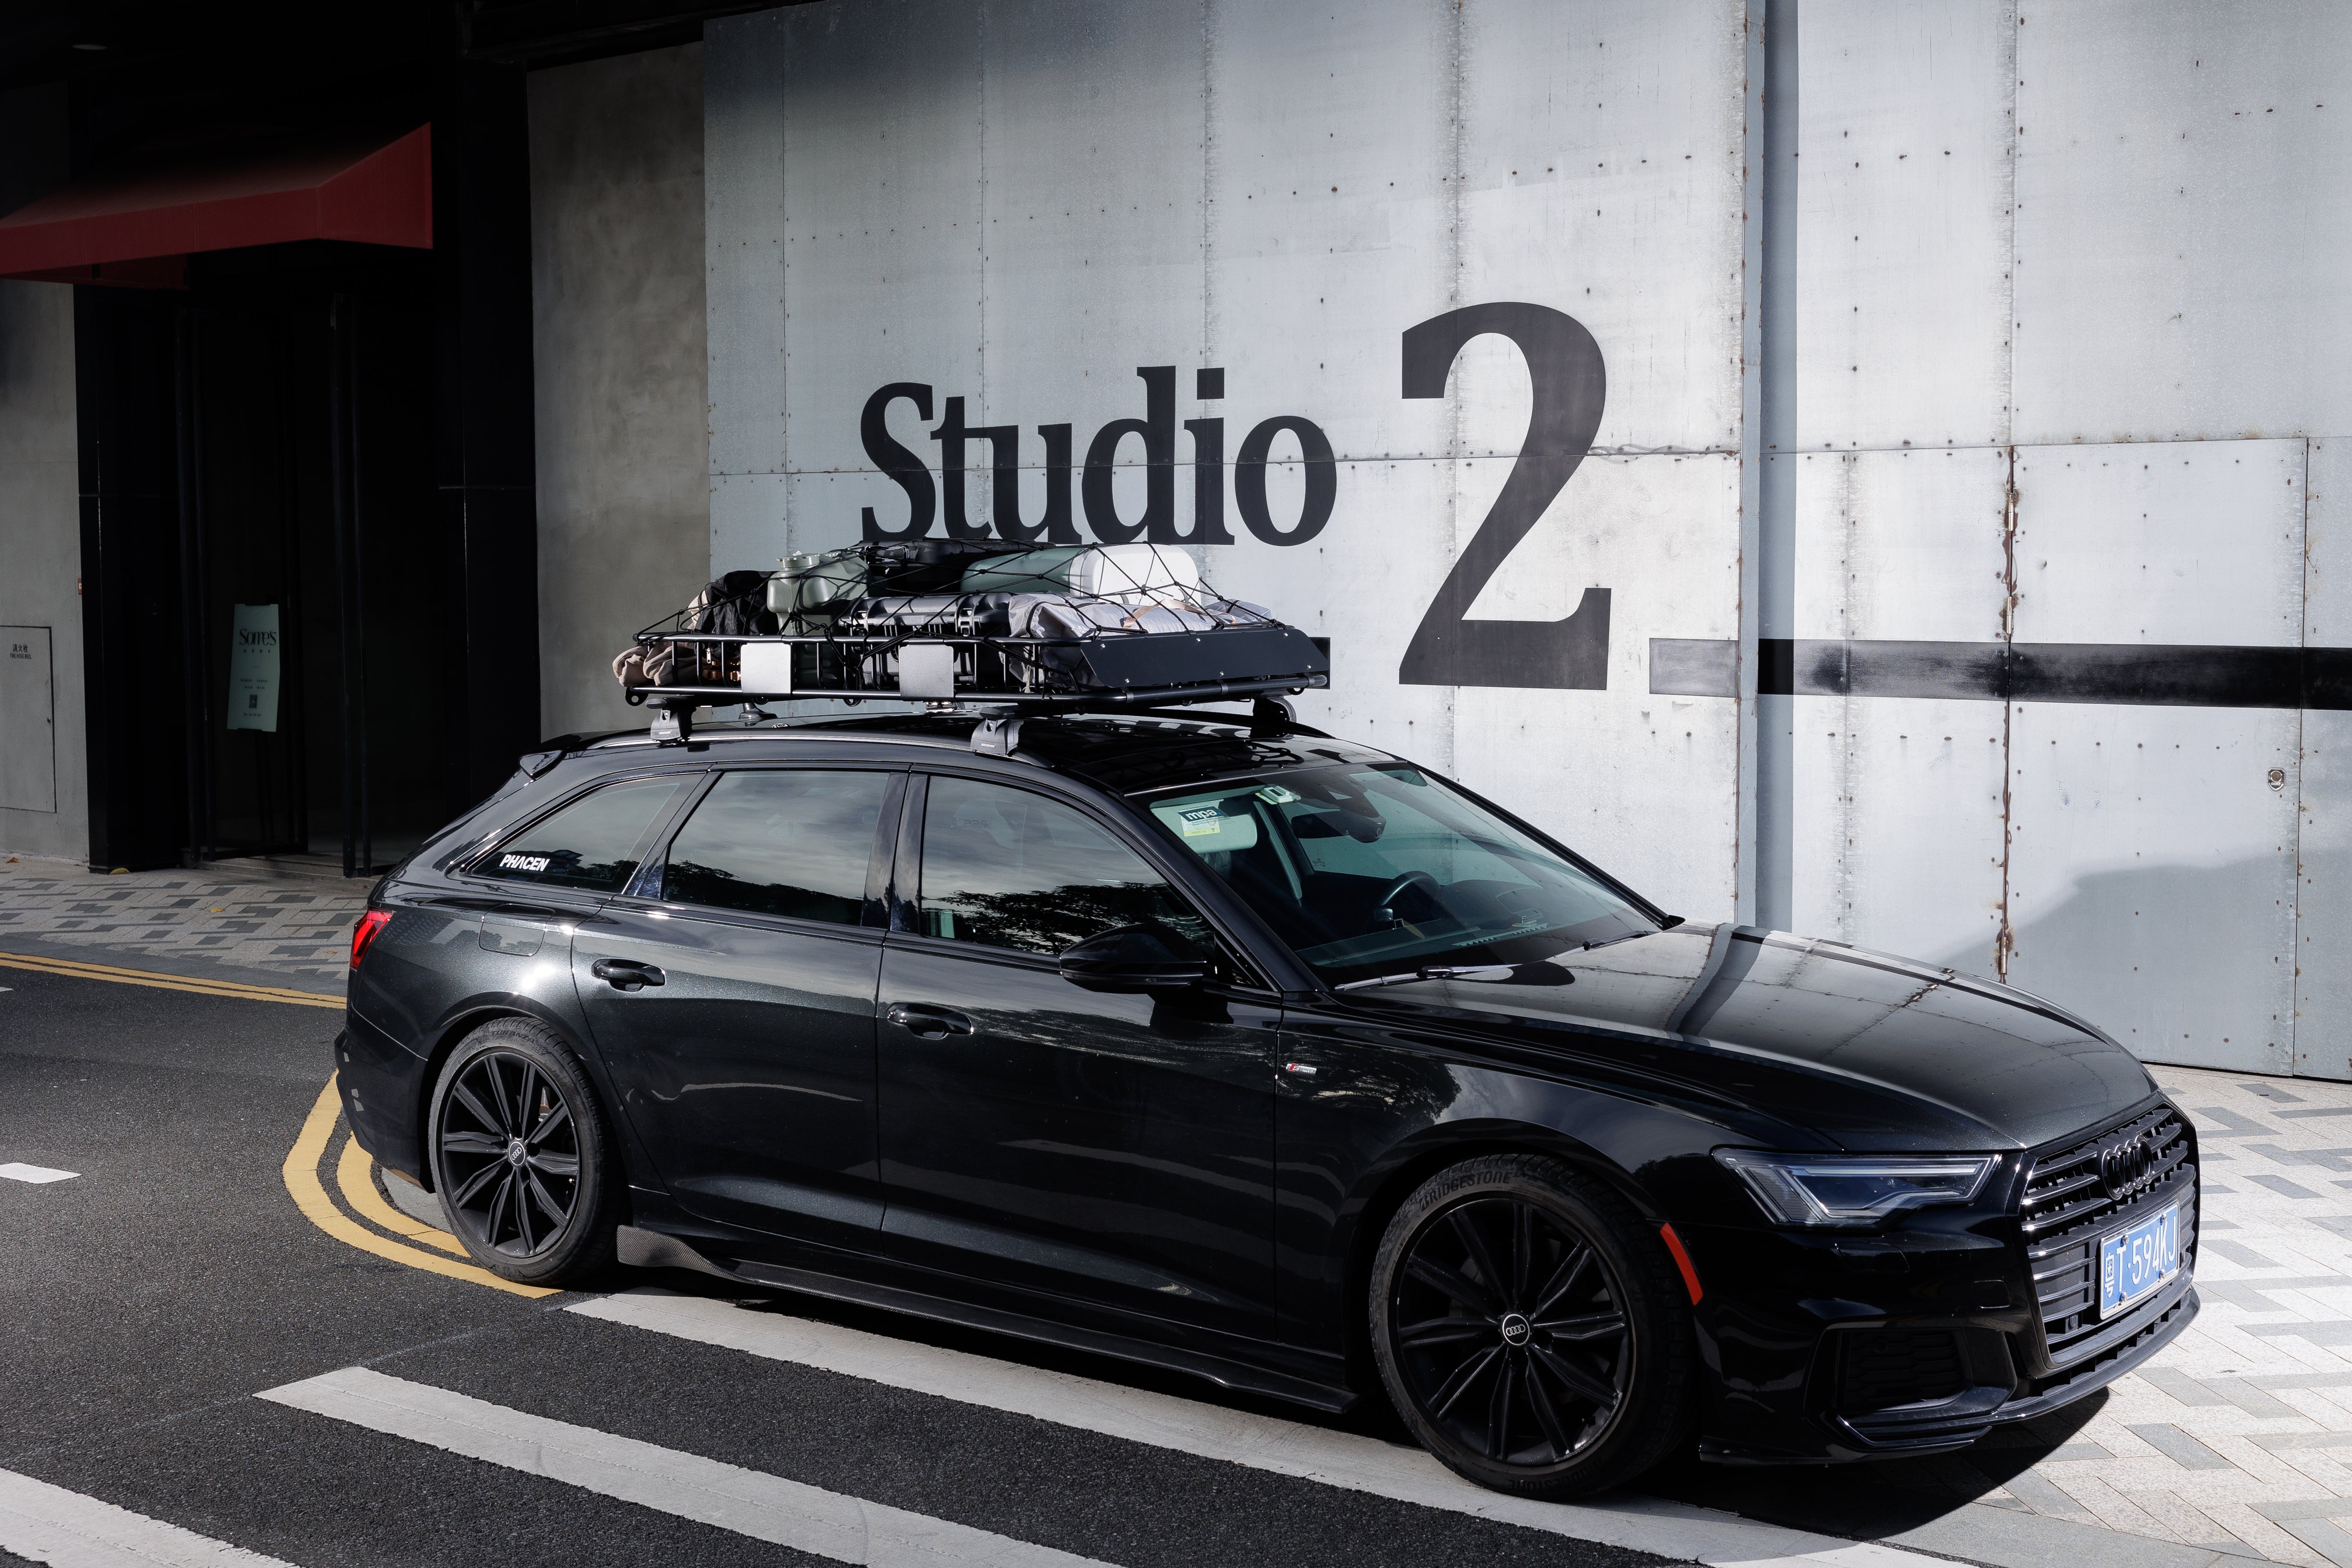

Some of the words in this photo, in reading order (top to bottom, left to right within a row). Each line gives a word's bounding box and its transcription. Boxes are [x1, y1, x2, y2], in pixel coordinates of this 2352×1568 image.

[860, 366, 1337, 546] Studio
[1399, 301, 1611, 690] 2
[13, 643, 29, 653] 消火栓
[490, 1029, 535, 1044] TURANZA
[1419, 1171, 1513, 1213] BRIDGESTONE
